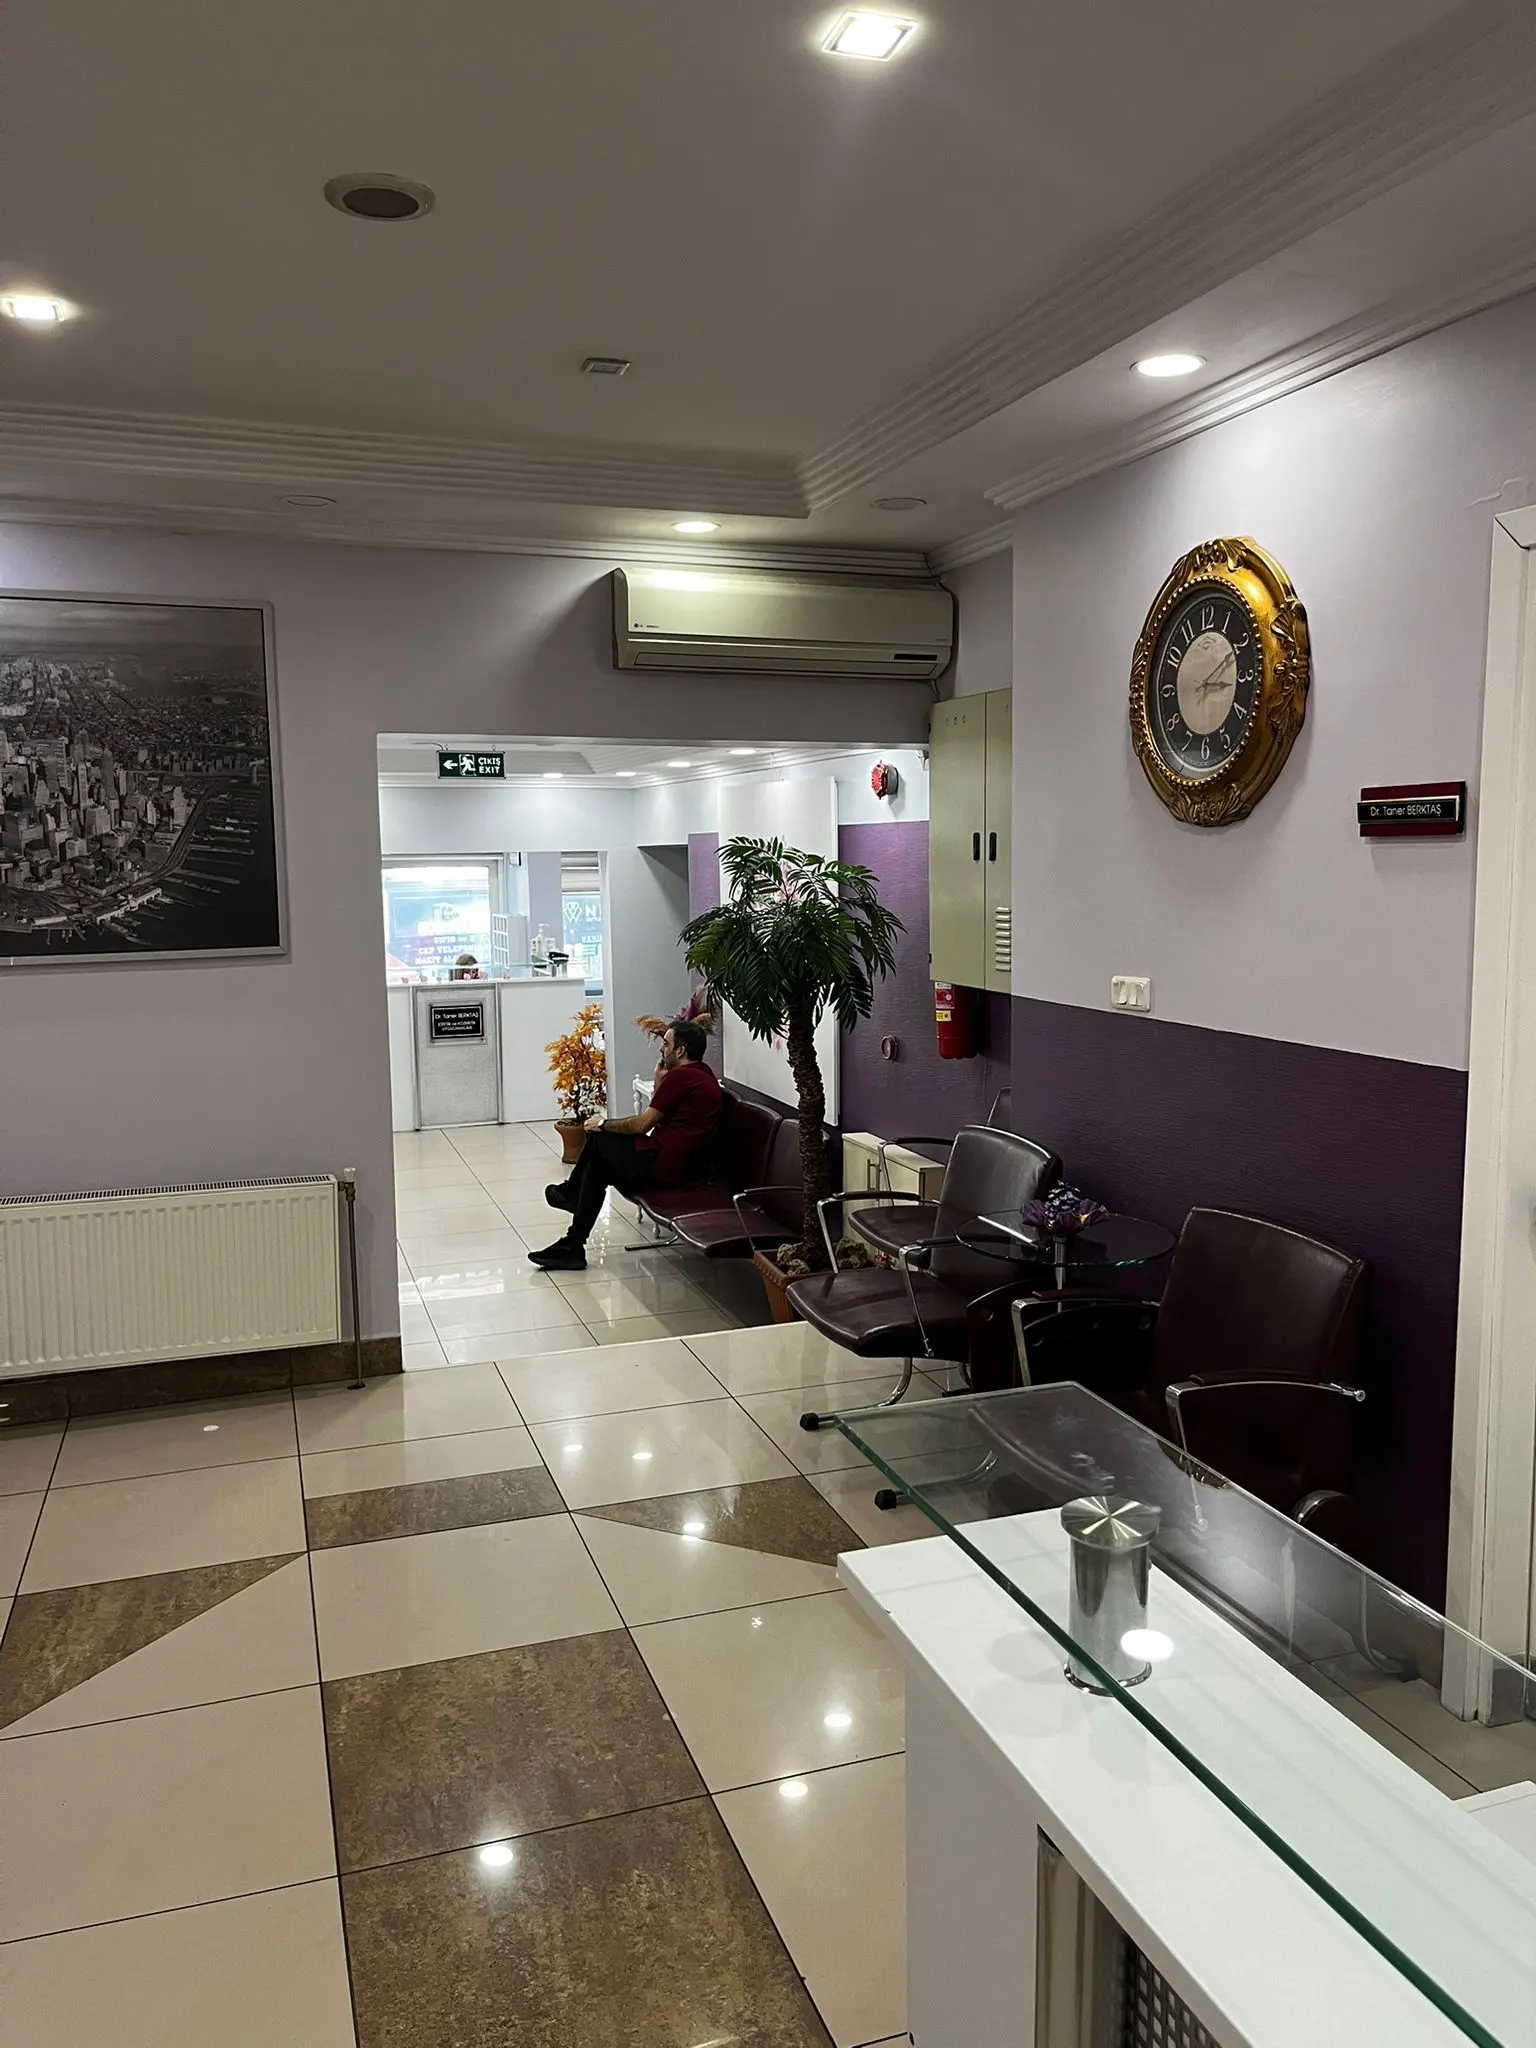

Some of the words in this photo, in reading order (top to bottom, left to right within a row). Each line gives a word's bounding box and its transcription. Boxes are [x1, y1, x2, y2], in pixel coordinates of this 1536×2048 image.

[1201, 605, 1215, 631] 12
[1221, 611, 1231, 634] 1
[1180, 619, 1195, 646] 11
[1233, 632, 1249, 655] 2
[1167, 646, 1182, 668] 10
[1236, 669, 1254, 684] 3
[1160, 684, 1176, 698] 9
[1166, 712, 1180, 731] 8
[1233, 702, 1247, 720] 4
[1182, 730, 1193, 751] 7
[1201, 736, 1210, 761] 6
[1219, 727, 1231, 749] 5
[479, 766, 500, 774] EXIT
[1370, 806, 1382, 817] Dr.
[1383, 806, 1406, 816] Taner
[1407, 803, 1442, 817] BERKTAŞ
